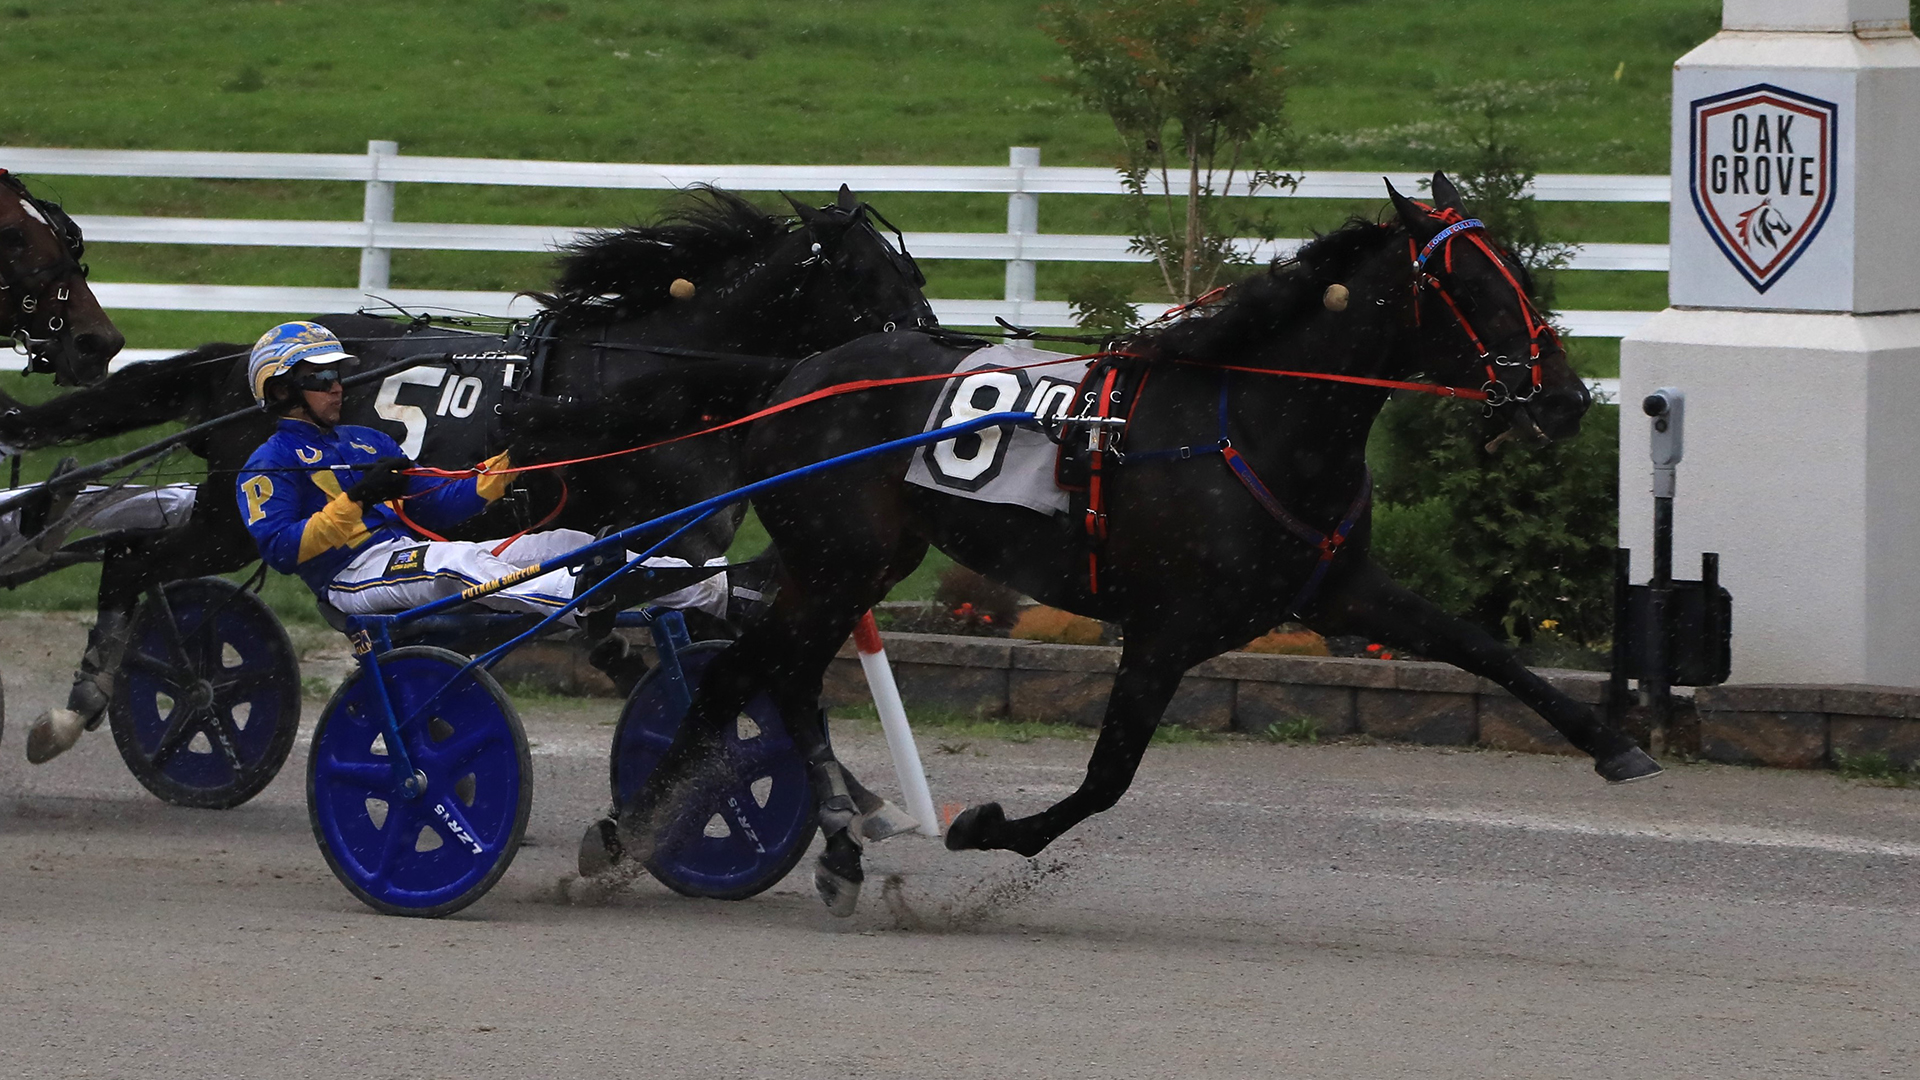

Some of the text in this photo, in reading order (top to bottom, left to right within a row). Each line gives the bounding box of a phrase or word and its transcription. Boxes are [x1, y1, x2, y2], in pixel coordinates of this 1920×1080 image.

[1733, 113, 1794, 154] OAK
[1711, 154, 1815, 196] GROVE
[374, 365, 483, 461] 5 10
[932, 371, 1022, 482] 8
[240, 474, 274, 527] P
[461, 562, 541, 600] PUTNAM SHIPPING
